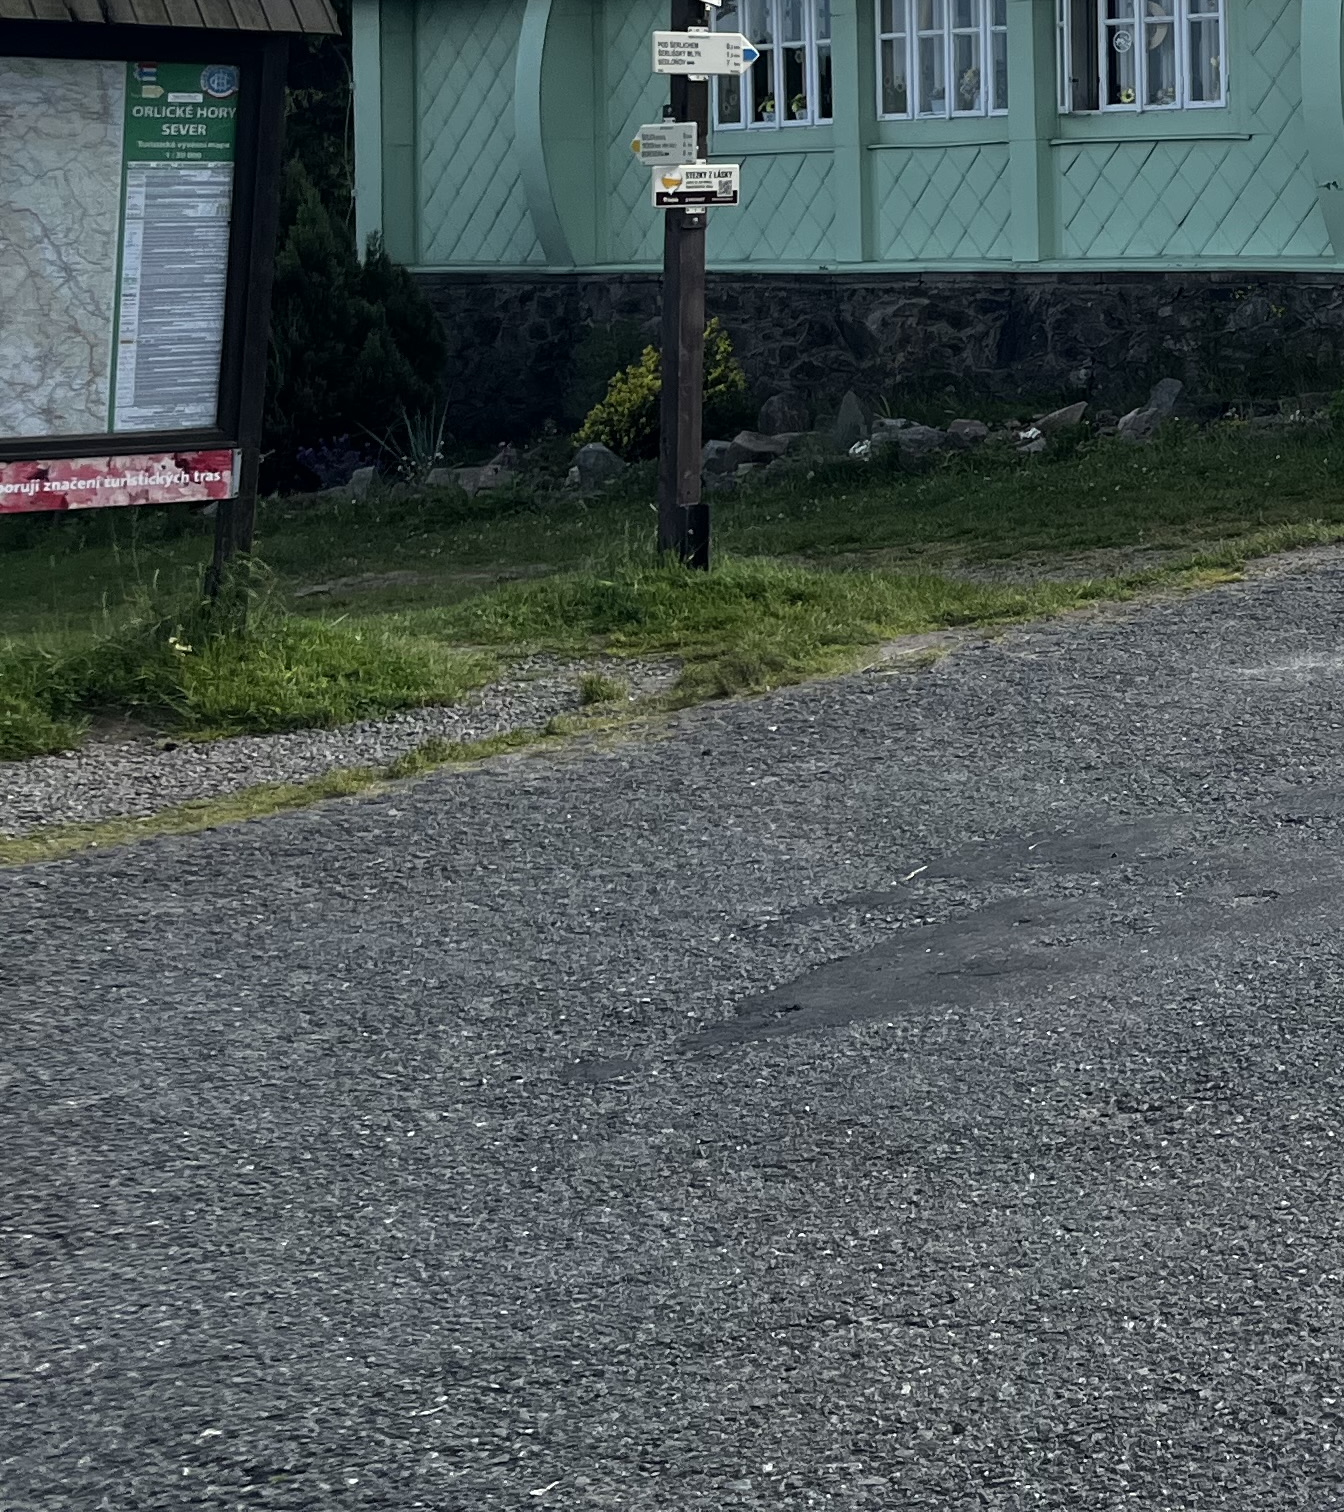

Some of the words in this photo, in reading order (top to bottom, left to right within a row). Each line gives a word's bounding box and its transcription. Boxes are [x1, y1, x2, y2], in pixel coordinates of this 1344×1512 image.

[132, 105, 194, 118] ORLICKÉ
[196, 107, 237, 119] HORY
[161, 123, 207, 136] SEVER
[104, 469, 189, 488] turistických
[193, 470, 221, 484] tras
